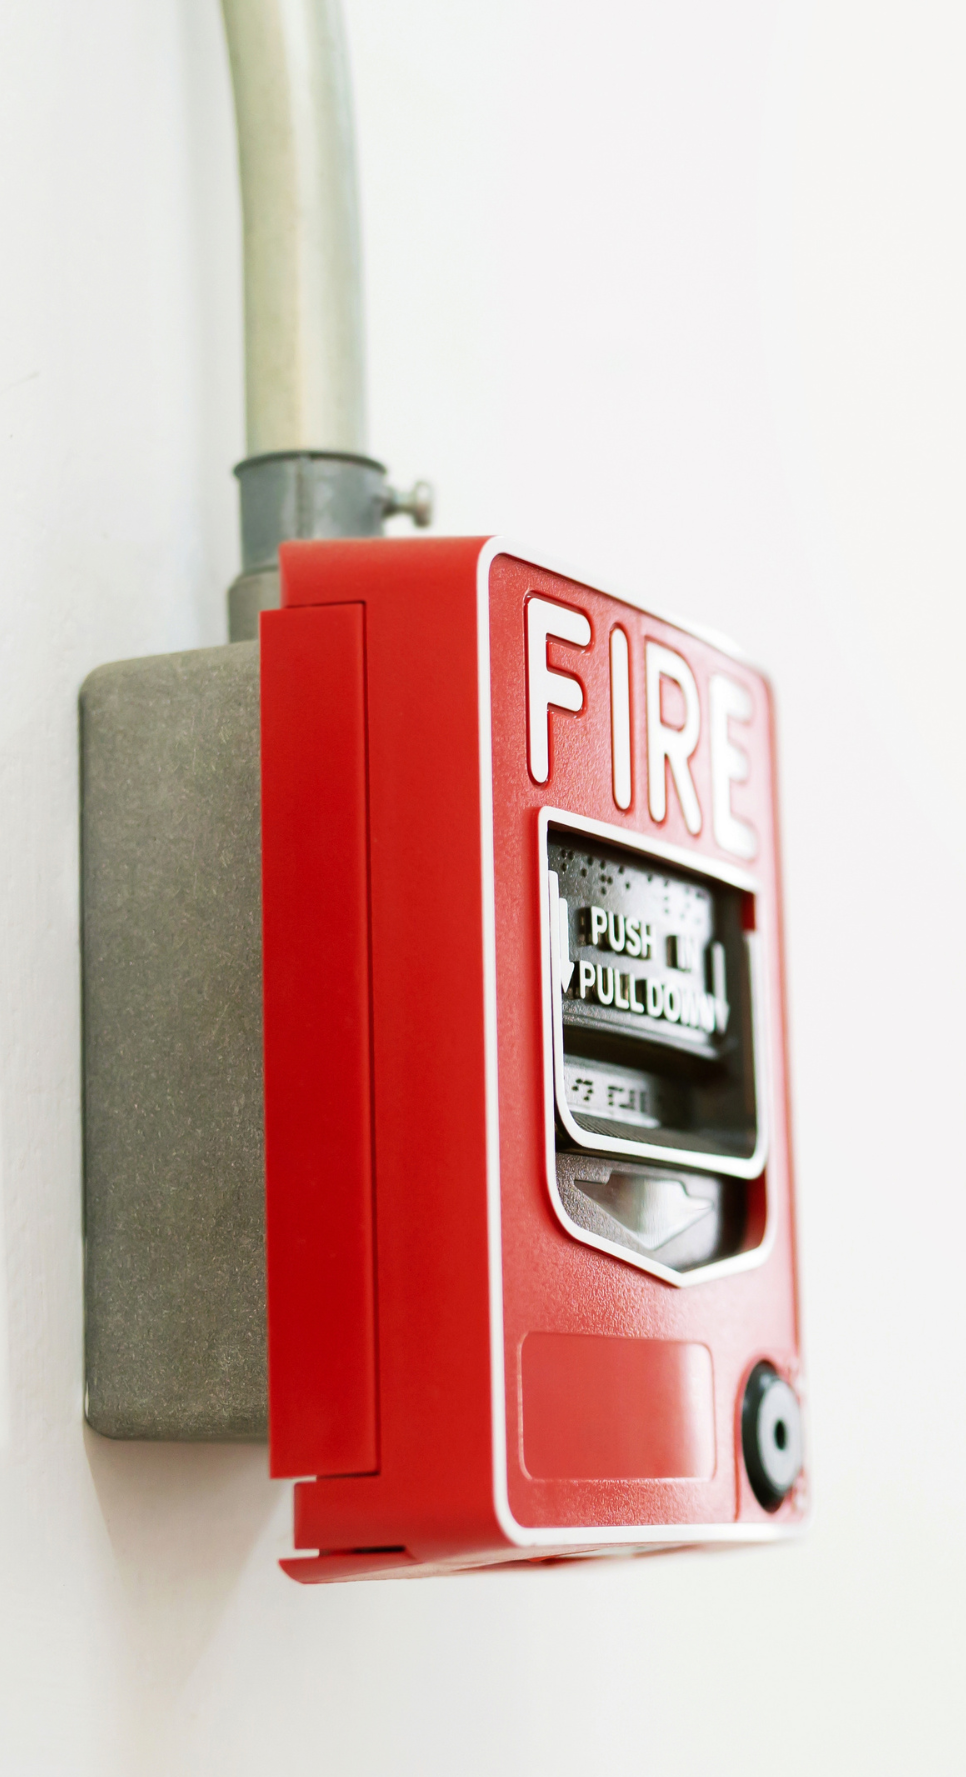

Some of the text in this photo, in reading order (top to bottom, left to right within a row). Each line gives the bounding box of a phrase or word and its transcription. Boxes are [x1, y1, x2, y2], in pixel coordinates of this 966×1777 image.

[527, 597, 757, 860] FIRE
[591, 905, 656, 958] PUSH
[579, 959, 716, 1034] PULL DOWN
